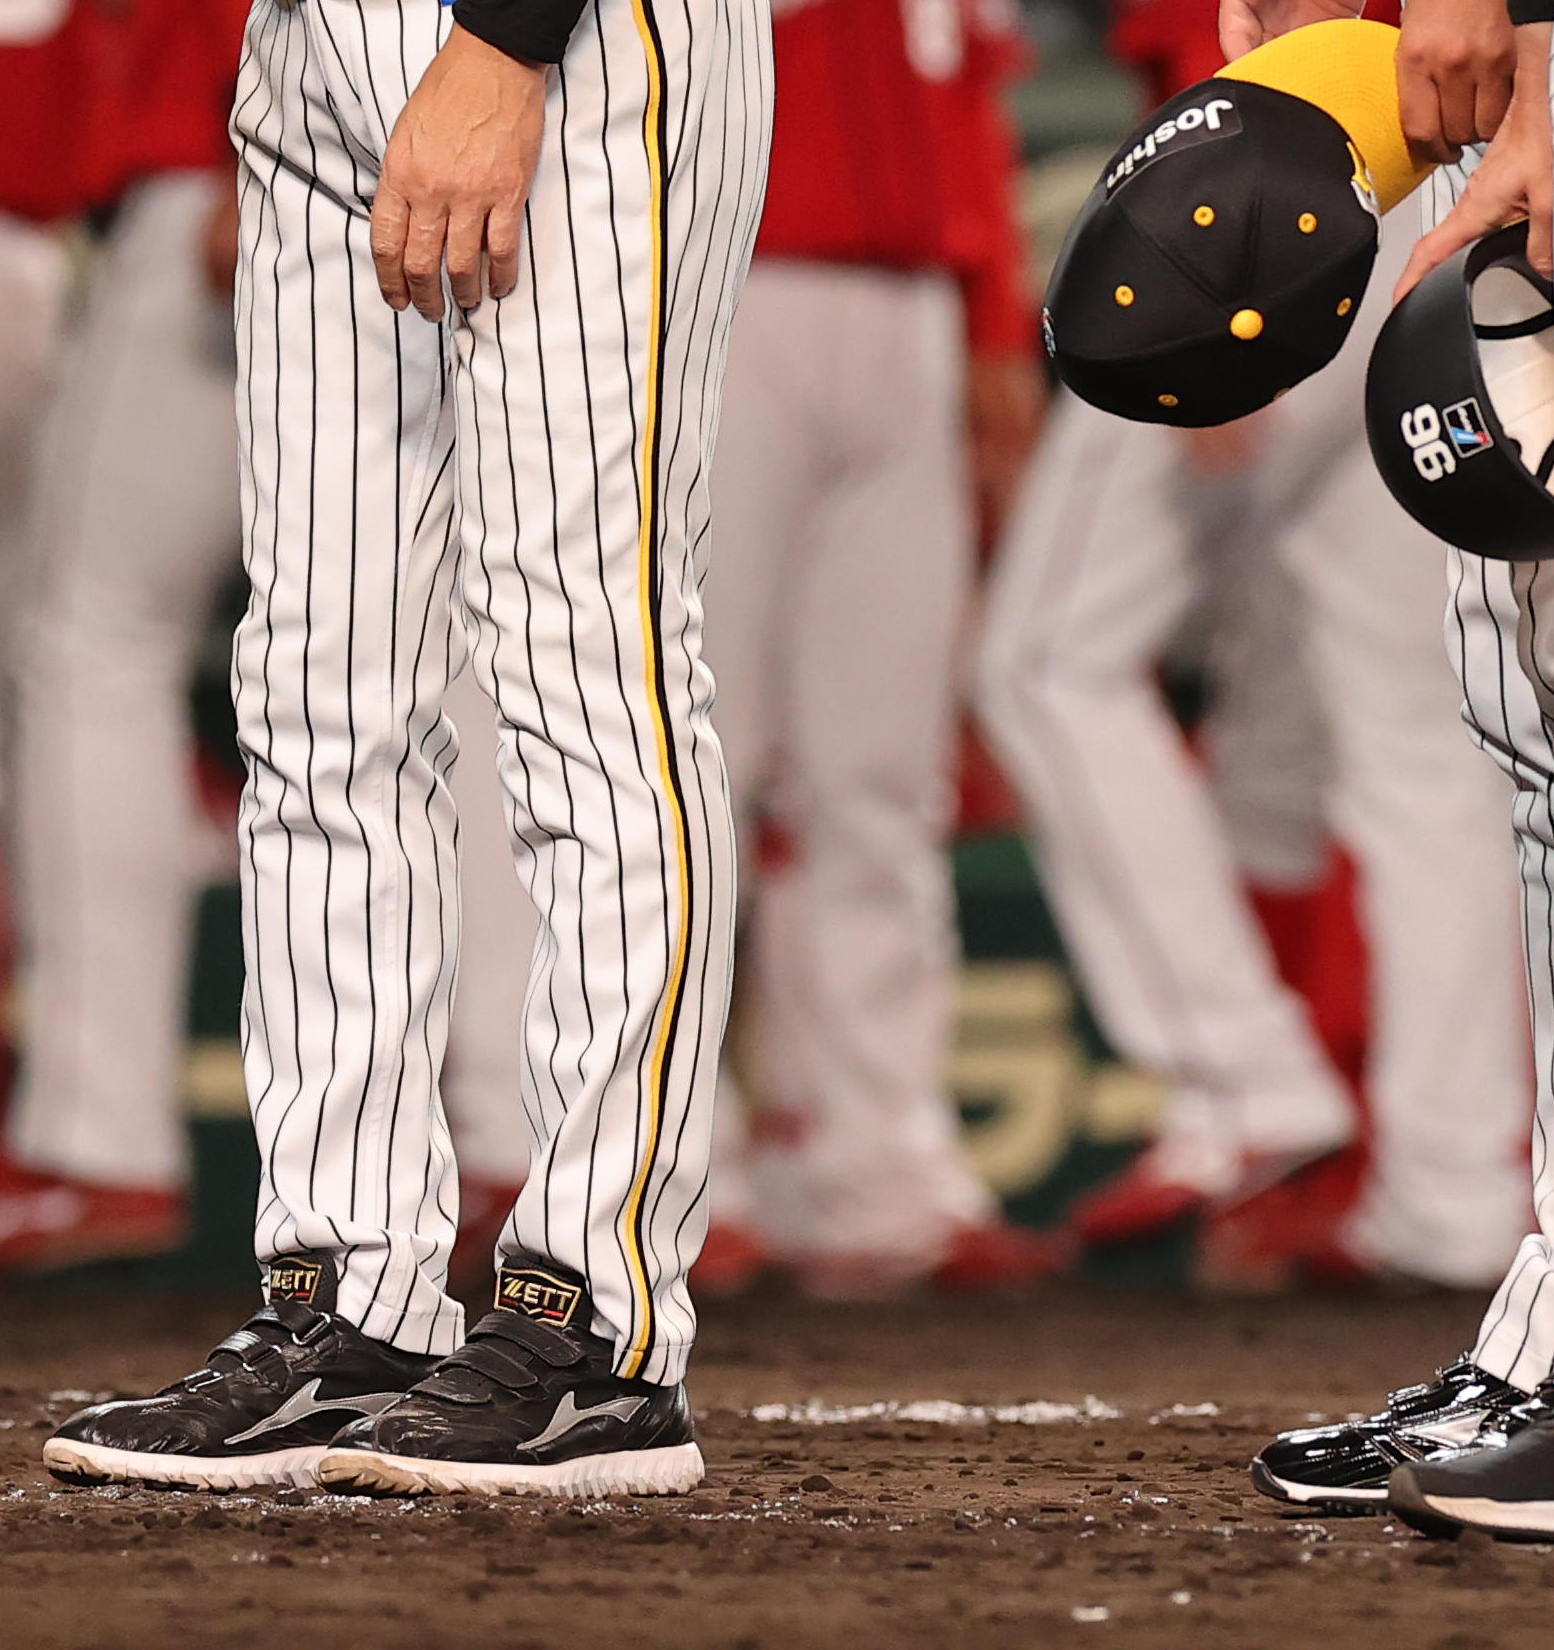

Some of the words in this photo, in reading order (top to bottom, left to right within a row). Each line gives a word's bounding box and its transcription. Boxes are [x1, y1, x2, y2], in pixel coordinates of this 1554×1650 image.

[1107, 99, 1233, 188] Joshin
[1401, 403, 1456, 482] 96
[270, 1268, 316, 1290] ZETT
[502, 1276, 573, 1310] ZETT
